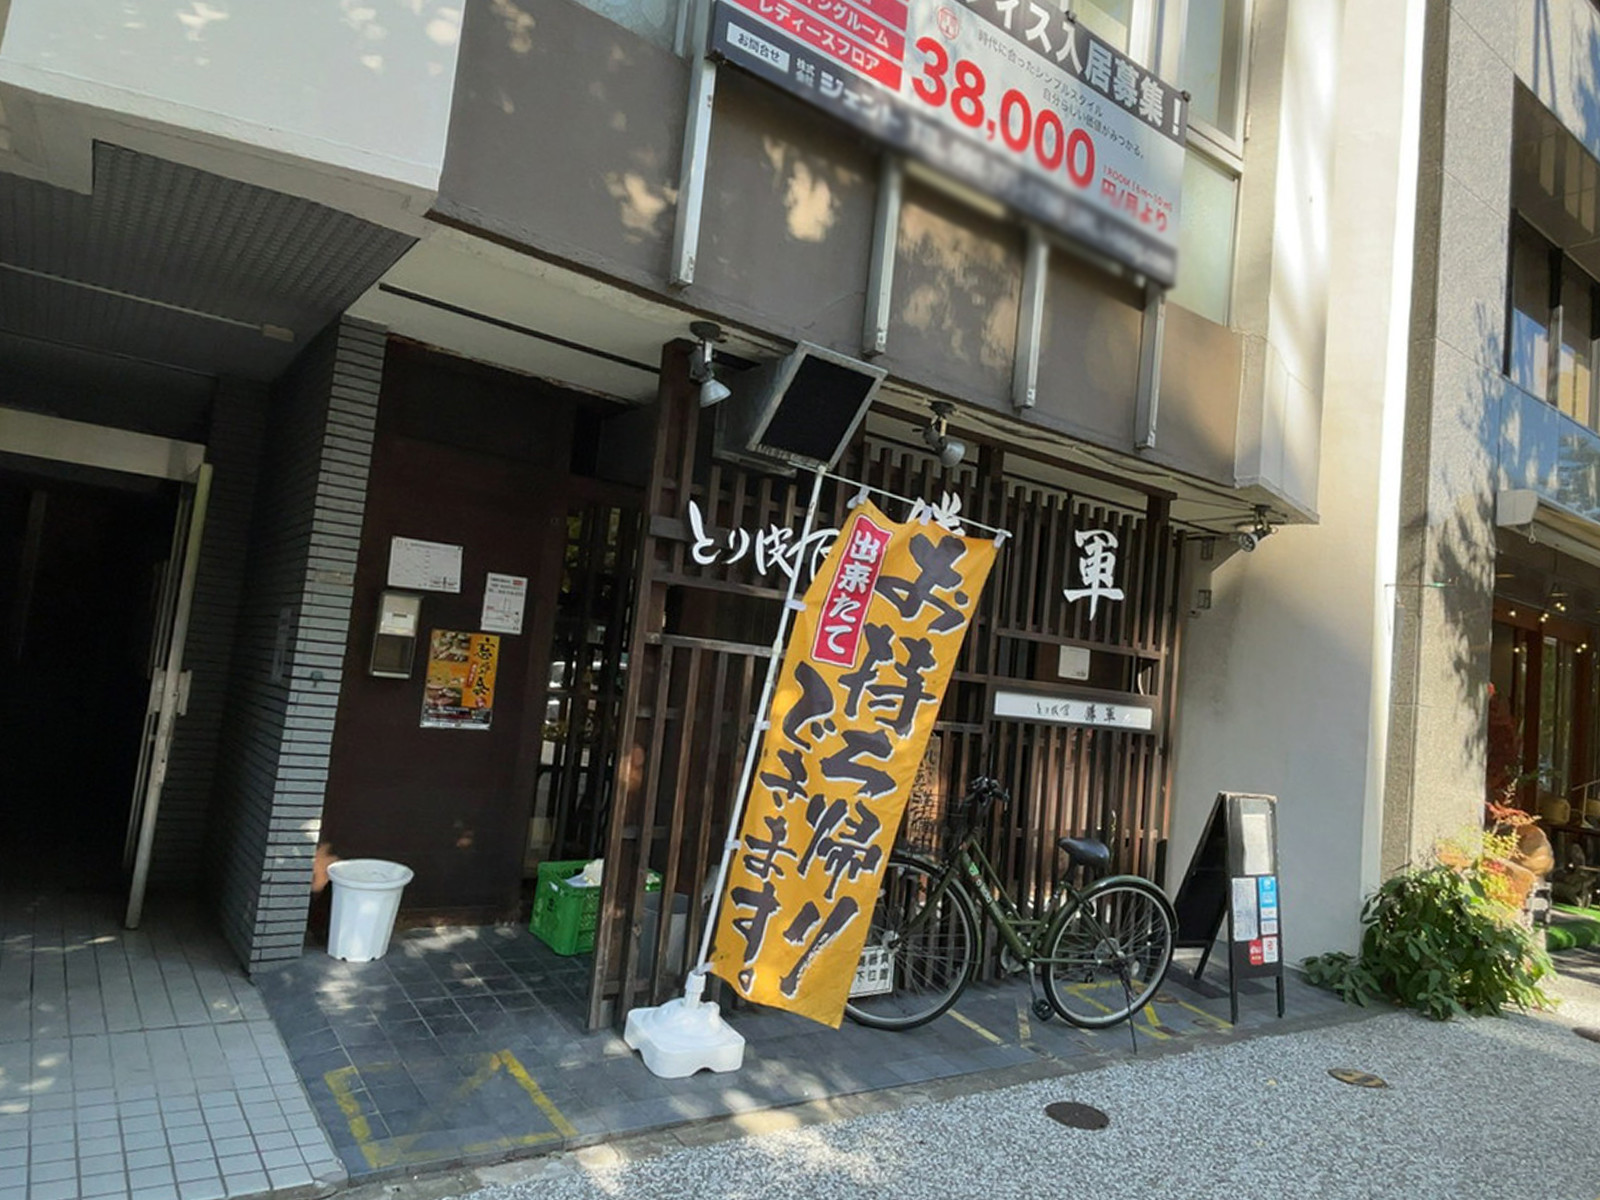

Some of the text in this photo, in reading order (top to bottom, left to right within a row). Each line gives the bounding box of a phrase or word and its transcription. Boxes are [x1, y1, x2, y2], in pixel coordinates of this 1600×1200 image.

[737, 32, 782, 64] お問合せ
[757, 0, 881, 72] レディースフロア
[957, 0, 1183, 136] ィス入居募集！
[911, 37, 1096, 190] 38,000
[822, 530, 881, 656] 出来たて
[730, 660, 836, 995] できます。
